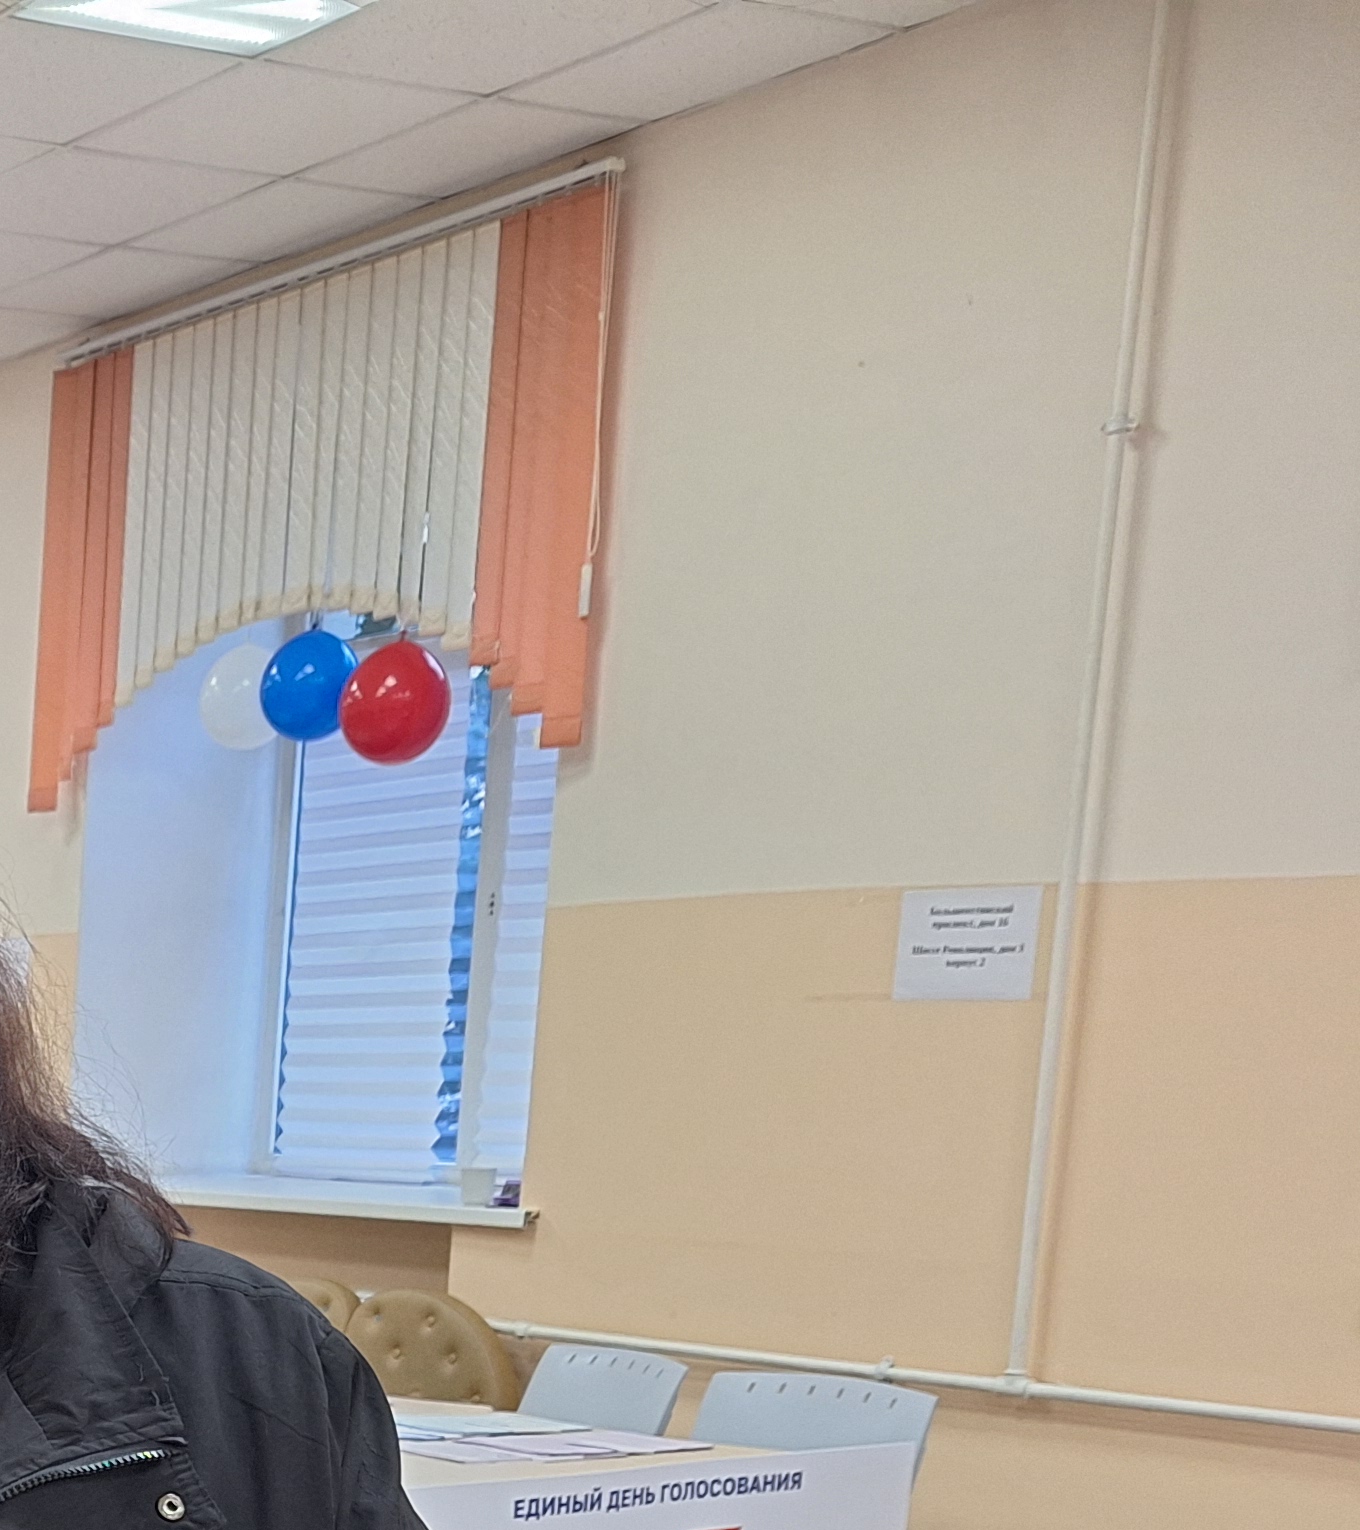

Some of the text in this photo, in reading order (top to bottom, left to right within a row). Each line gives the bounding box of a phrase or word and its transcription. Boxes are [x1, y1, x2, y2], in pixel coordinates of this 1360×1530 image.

[512, 1471, 803, 1521] ЕДИНЫЙ ДЕНЬ ГОЛОСОВАНИЯ
